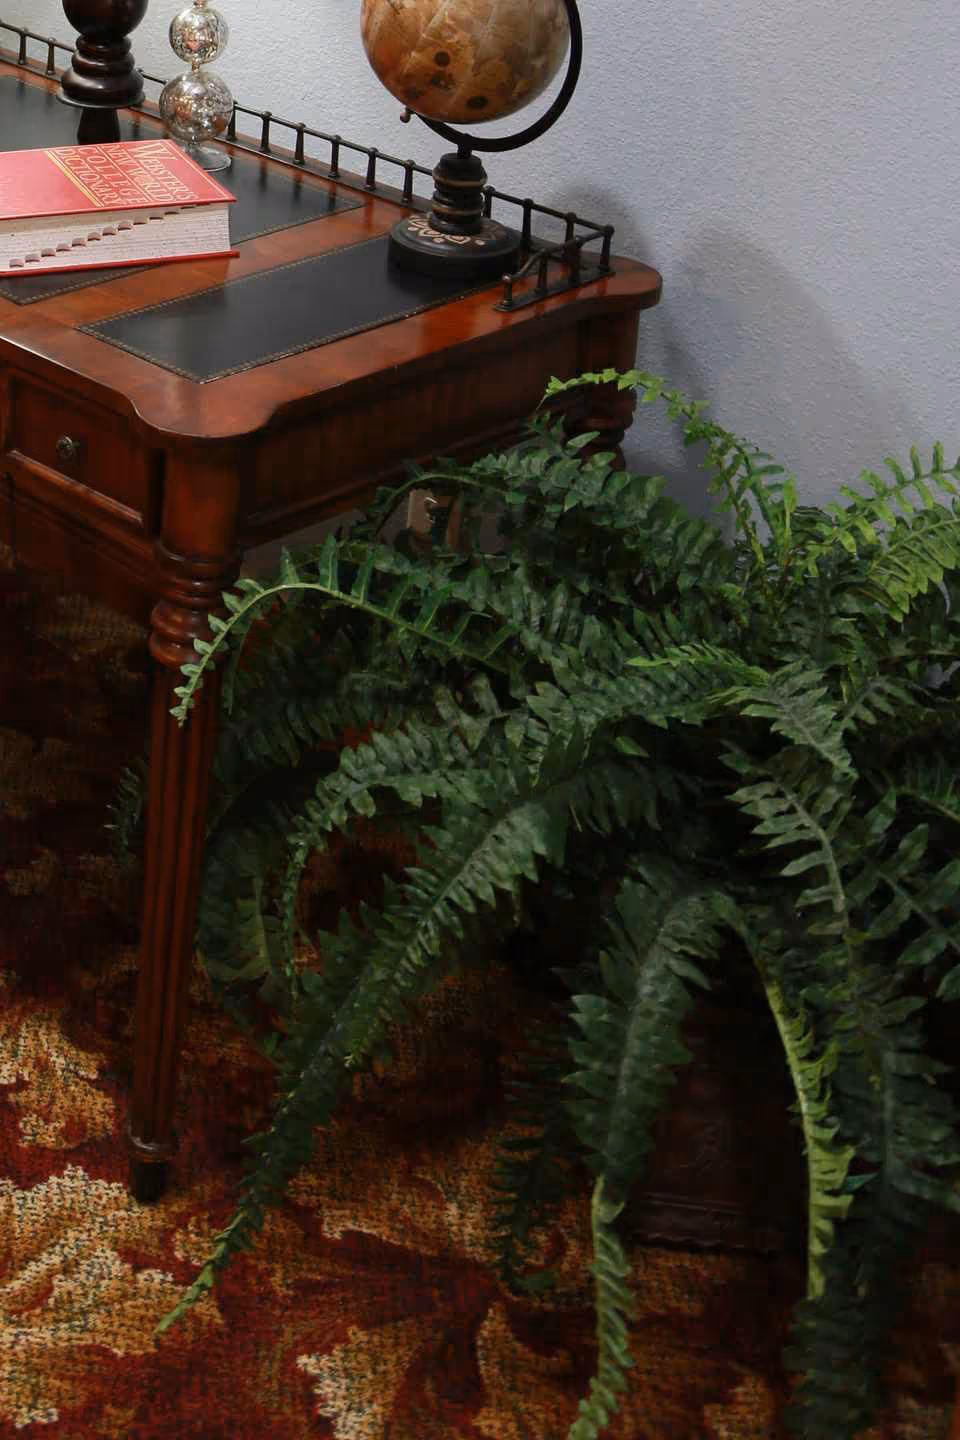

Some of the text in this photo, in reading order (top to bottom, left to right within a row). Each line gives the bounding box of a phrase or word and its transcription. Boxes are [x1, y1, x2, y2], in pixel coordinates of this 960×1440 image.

[53, 149, 127, 206] DICTIONARY
[77, 147, 150, 204] COLLEGE
[102, 144, 177, 202] NEW WORLD
[126, 142, 199, 201] WEBSTER'S
